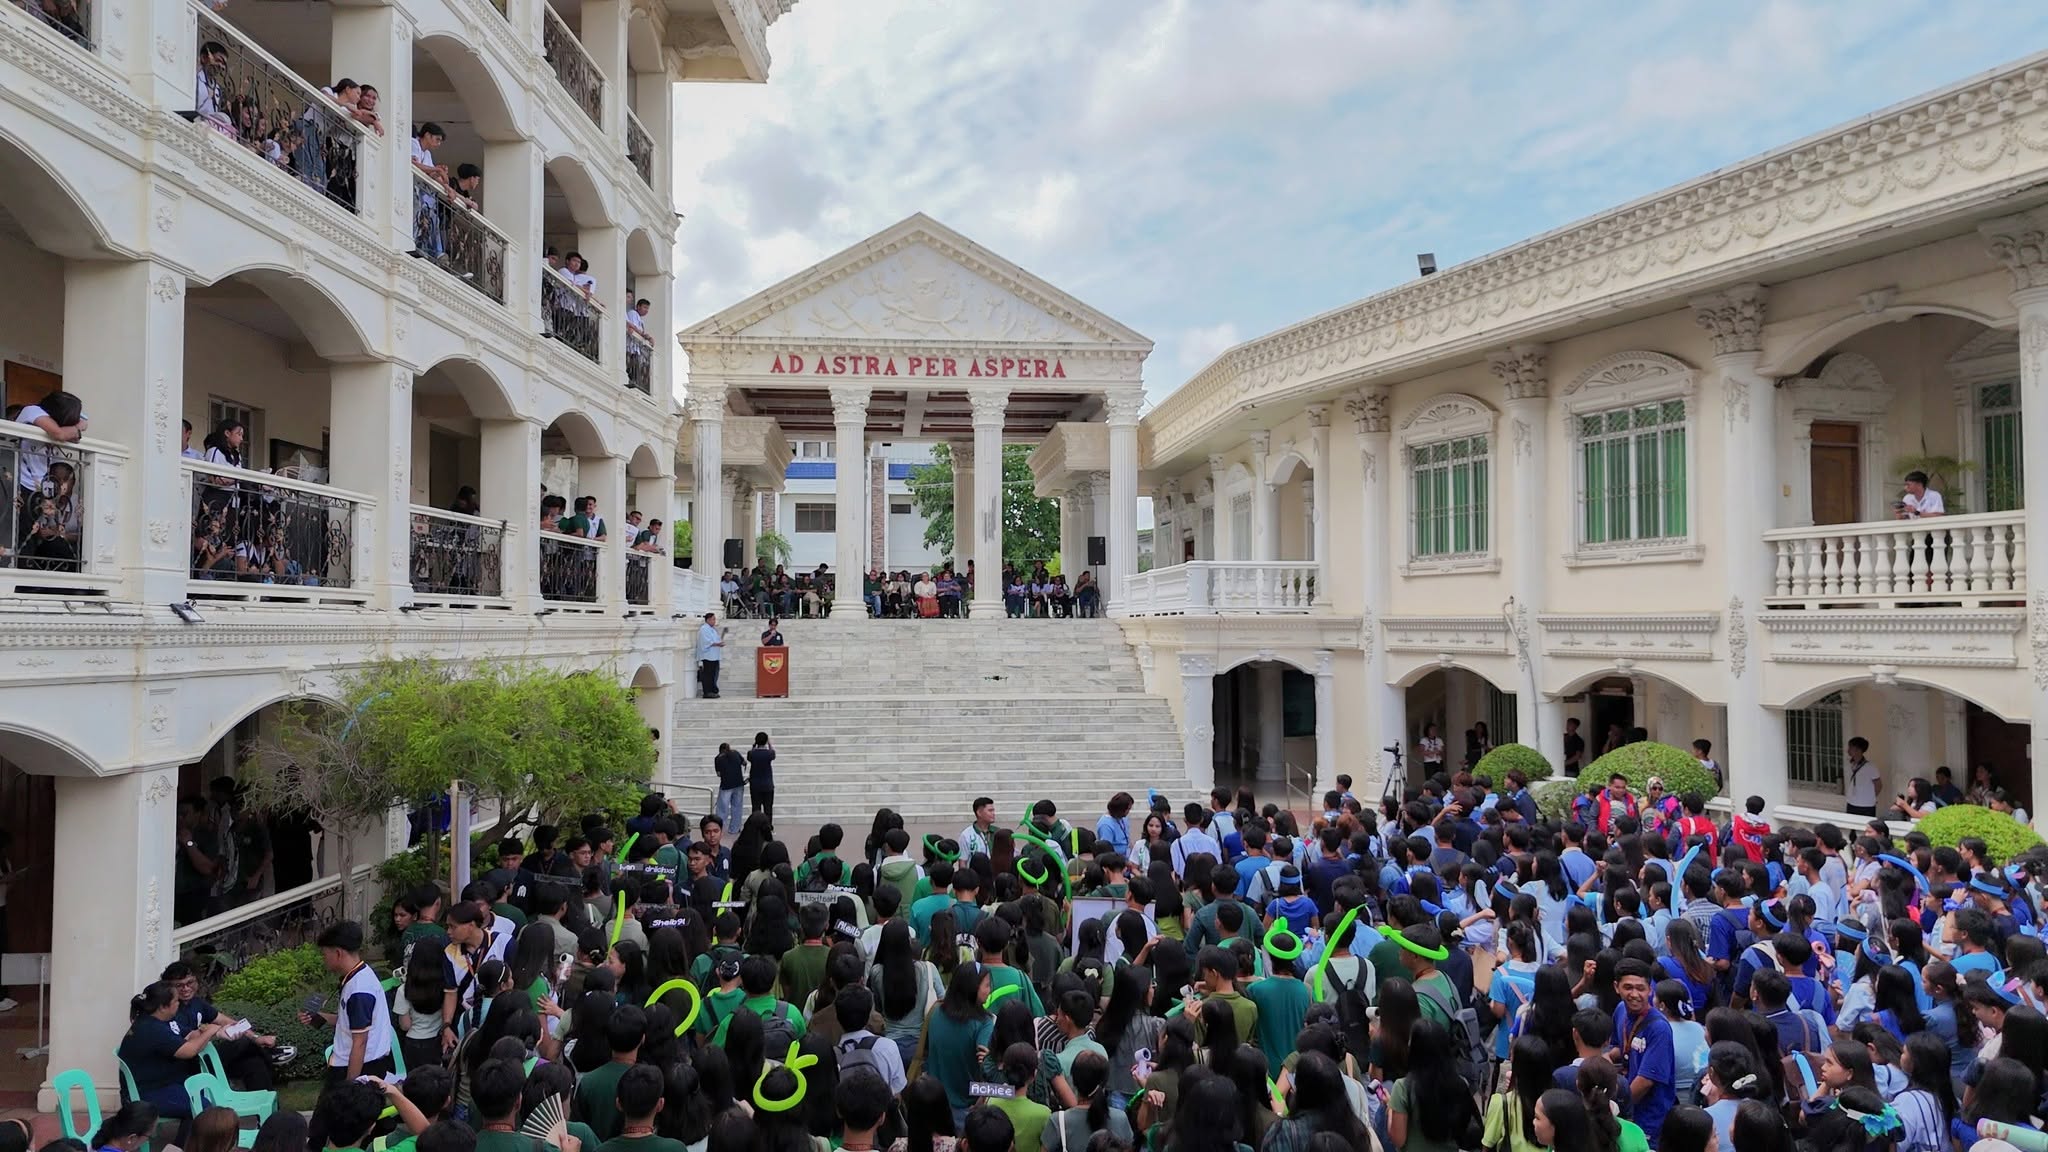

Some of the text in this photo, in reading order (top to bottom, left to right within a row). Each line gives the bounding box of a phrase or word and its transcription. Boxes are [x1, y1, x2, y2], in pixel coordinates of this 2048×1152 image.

[770, 354, 1066, 379] AD ASTRA PER ASPERA
[971, 1083, 1013, 1096] Achiee
